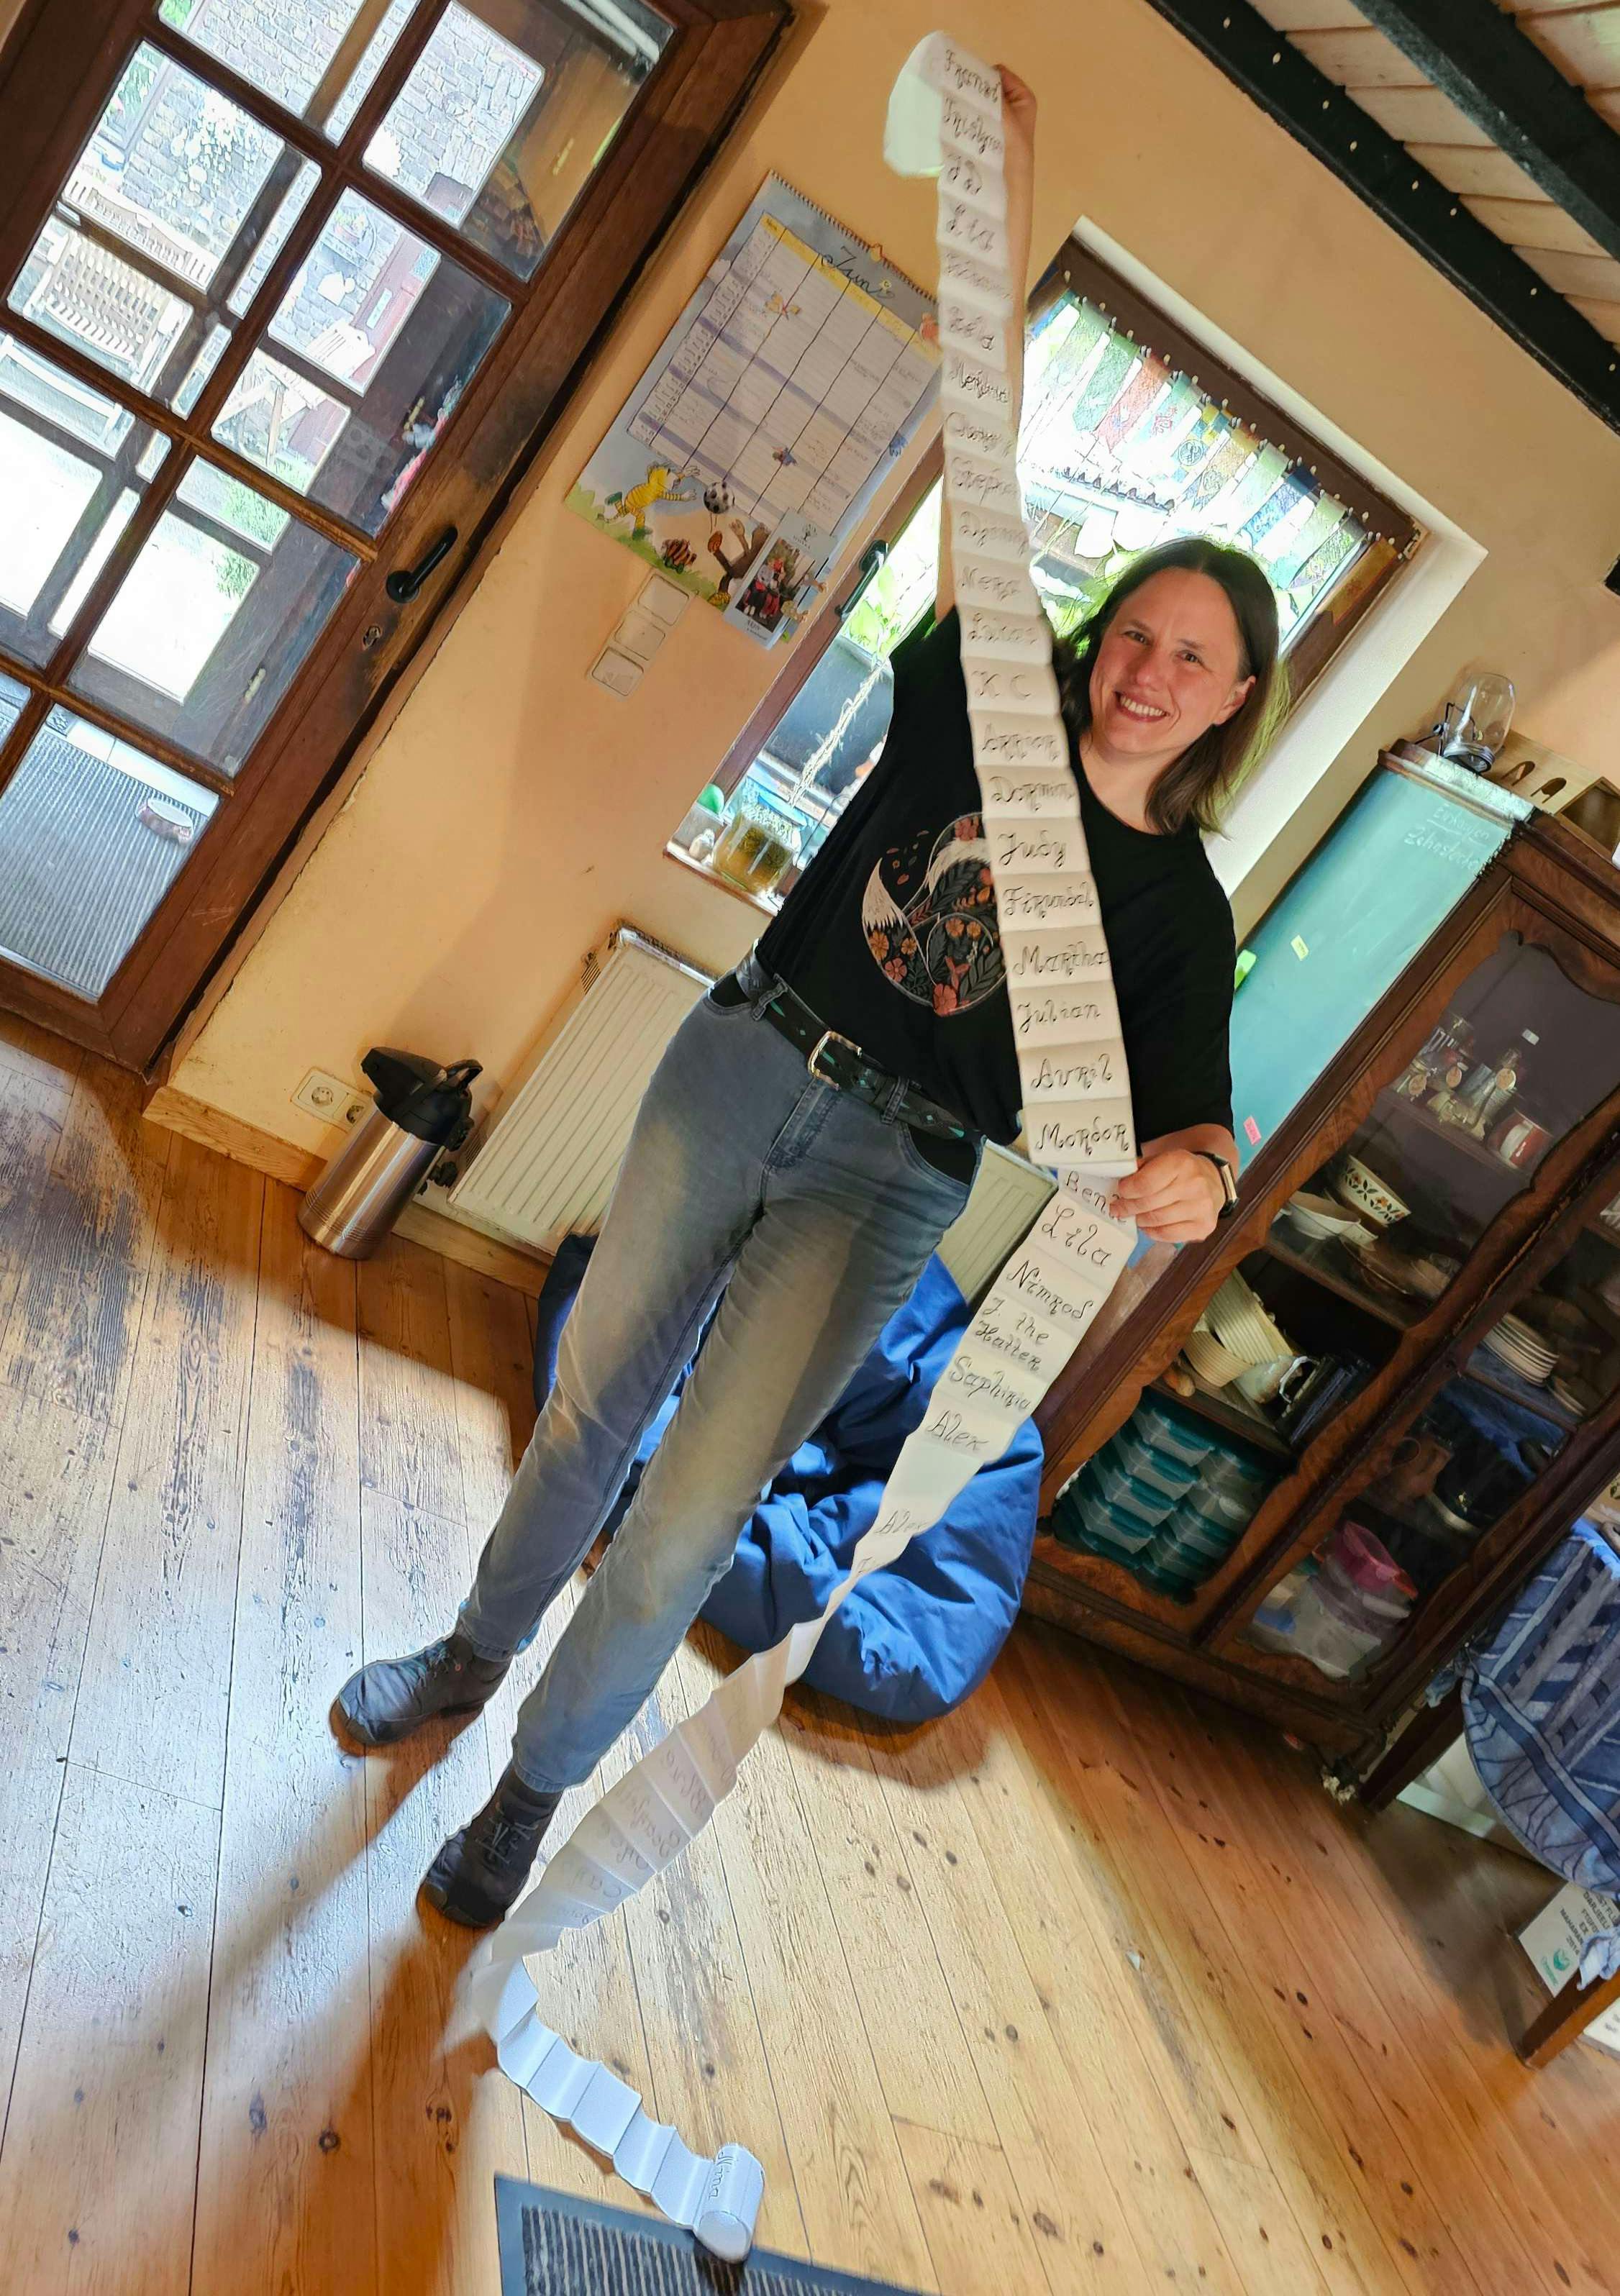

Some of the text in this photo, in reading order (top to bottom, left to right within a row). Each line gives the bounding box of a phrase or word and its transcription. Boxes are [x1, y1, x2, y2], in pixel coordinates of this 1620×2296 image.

[821, 246, 895, 300] Juni
[998, 829, 1068, 867] Judy
[1016, 999, 1101, 1034] Julian
[1034, 1116, 1129, 1156] Mordor
[1042, 1204, 1112, 1267] Lila
[1006, 1259, 1094, 1319] Nimrod
[975, 1321, 1043, 1372] Hatter
[1015, 1312, 1050, 1345] the
[927, 1409, 990, 1452] Alex
[1560, 1906, 1584, 1946] MAHARAN
